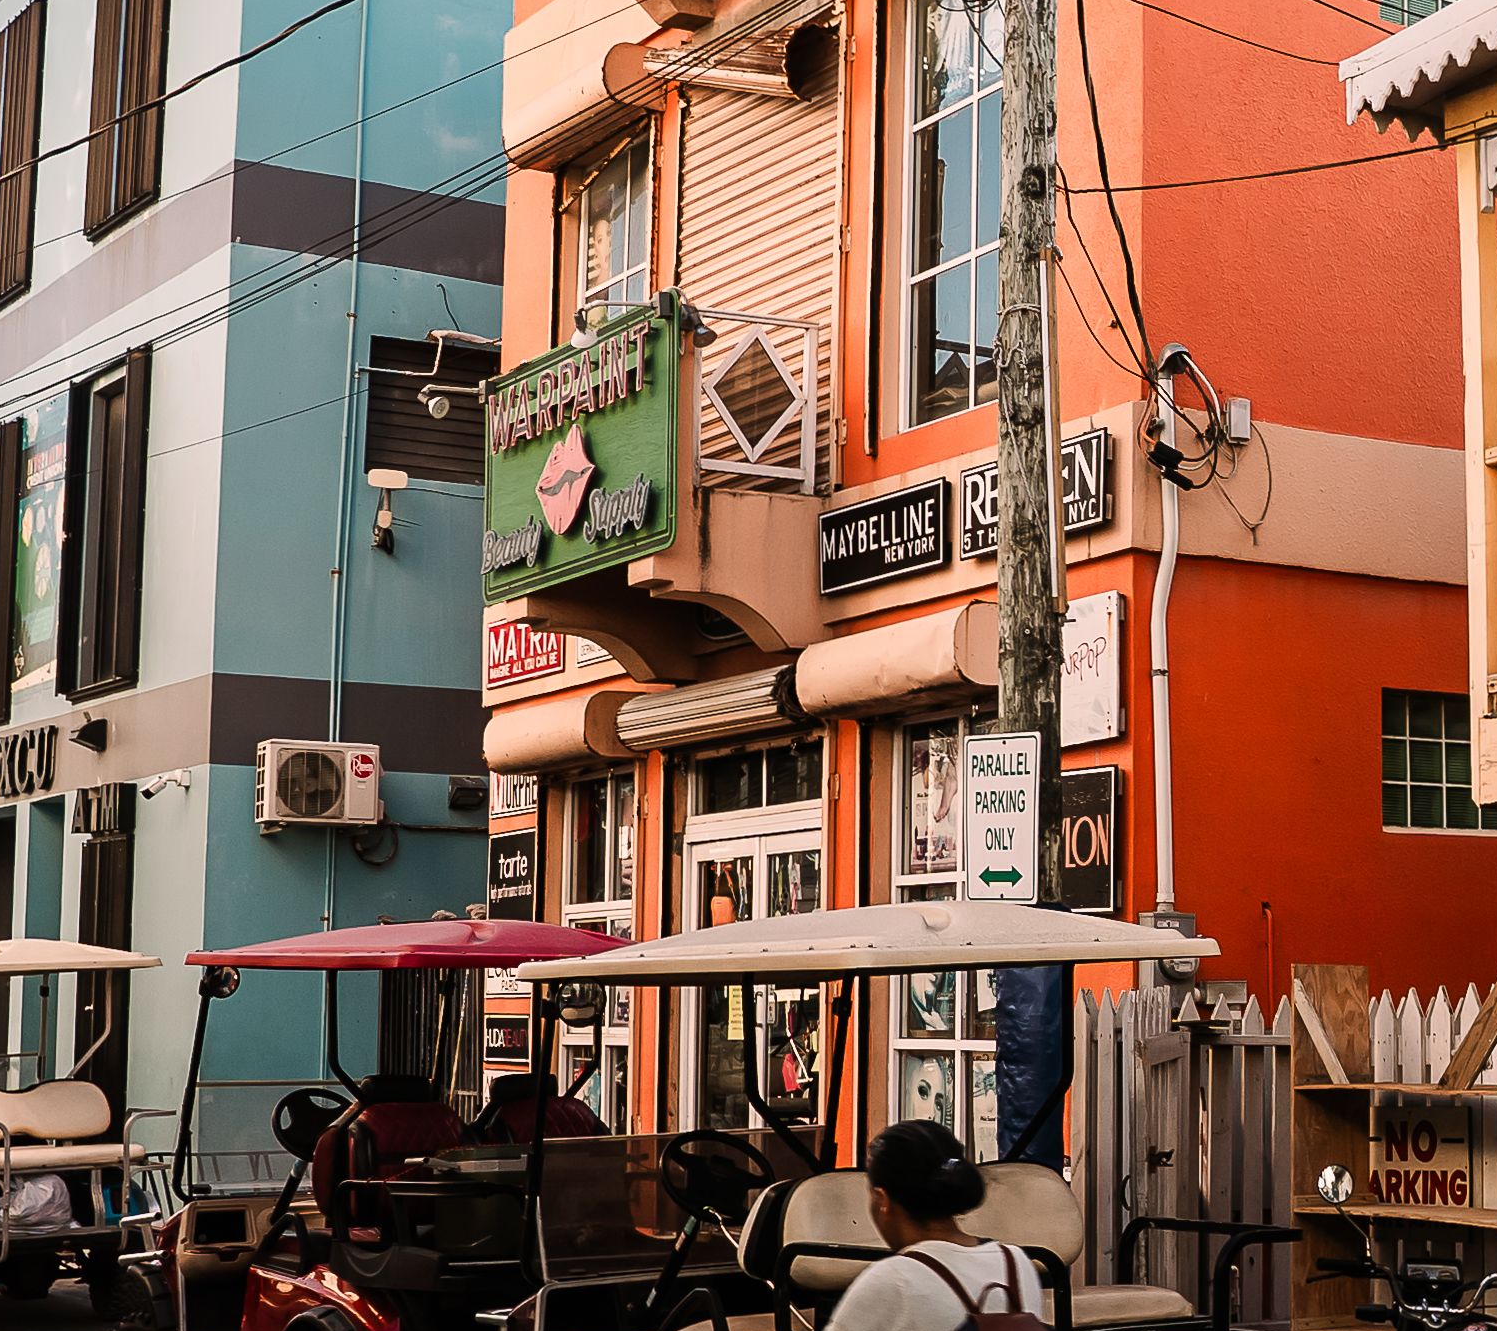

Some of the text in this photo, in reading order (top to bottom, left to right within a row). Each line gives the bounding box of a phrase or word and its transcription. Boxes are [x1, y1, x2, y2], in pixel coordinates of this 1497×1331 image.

[489, 321, 650, 455] WARPAINT
[583, 473, 652, 544] Supply
[1069, 496, 1097, 524] NYC
[481, 515, 543, 575] Beauty
[822, 499, 935, 563] MAYBELLINE
[885, 534, 935, 564] NEW YORK
[972, 753, 1030, 777] PARALLEL
[975, 790, 1025, 814] PARKING
[985, 827, 1015, 851] ONLY
[499, 850, 528, 880] tarte
[1385, 1120, 1438, 1163] NO
